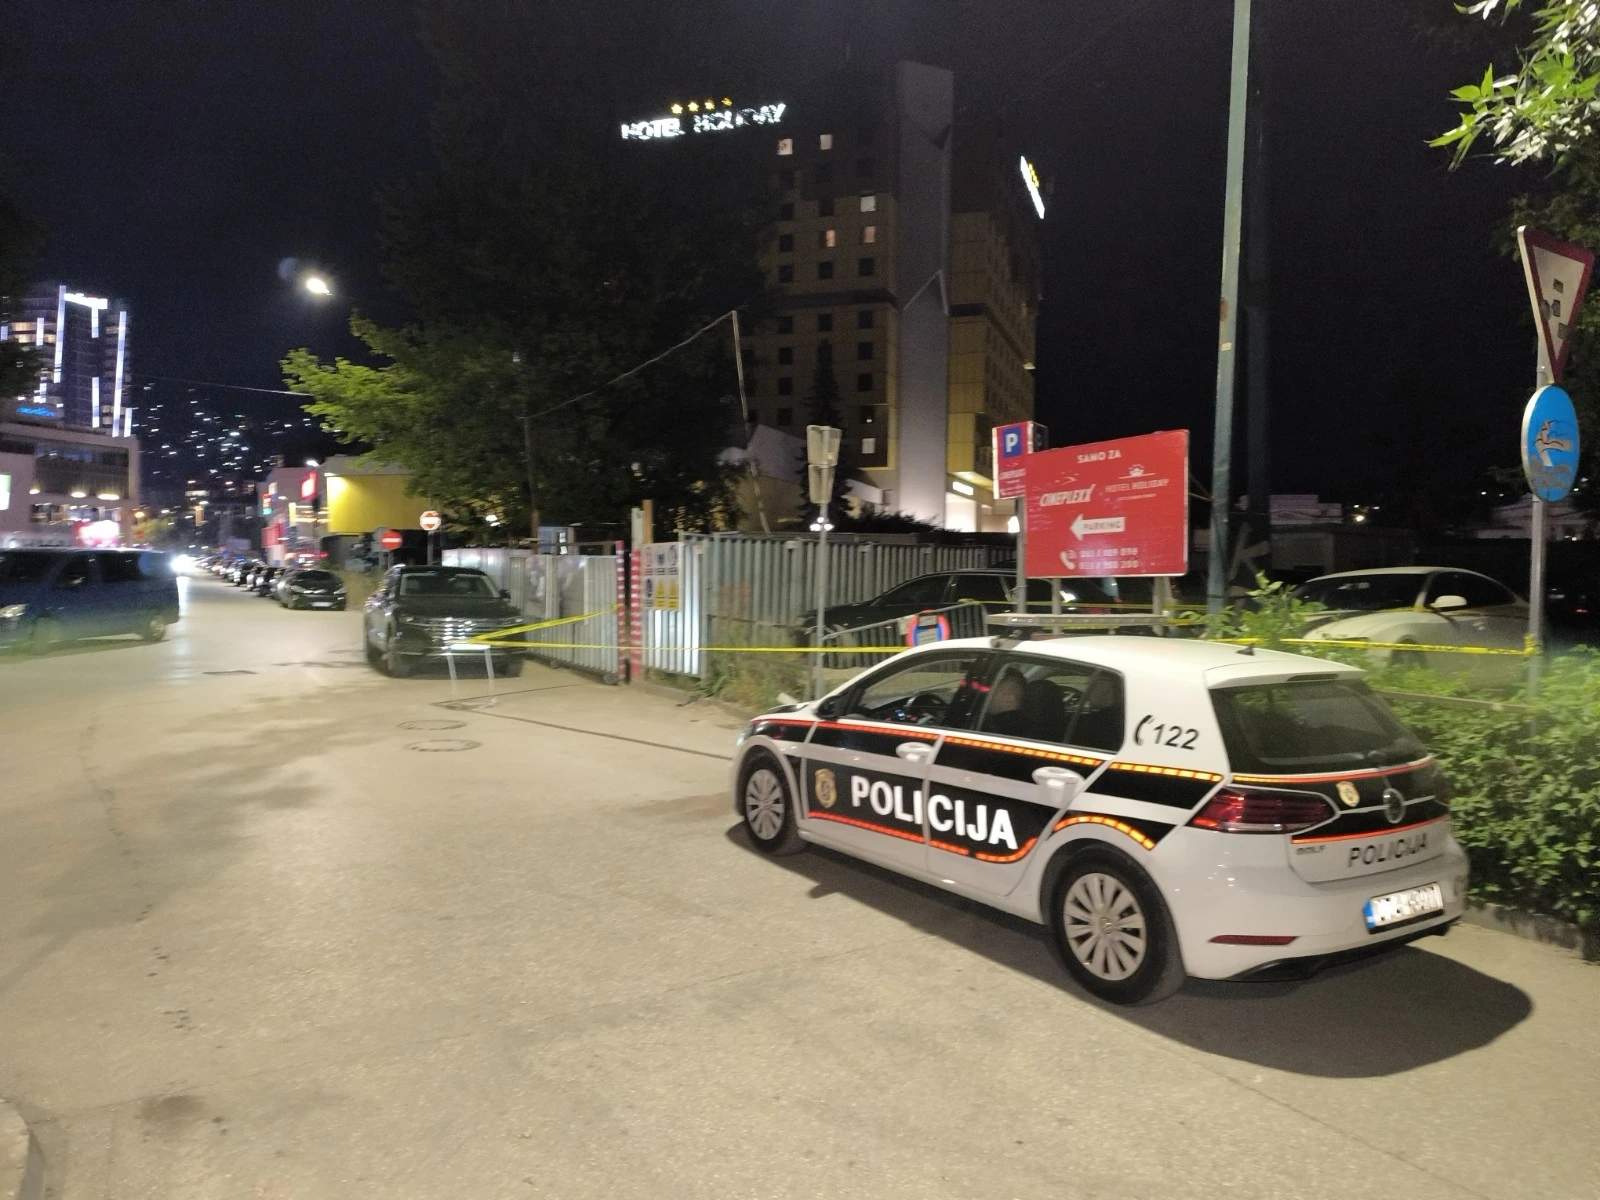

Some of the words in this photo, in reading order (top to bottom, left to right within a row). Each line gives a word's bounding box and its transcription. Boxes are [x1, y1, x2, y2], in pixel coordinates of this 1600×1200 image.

[621, 118, 685, 140] HOTEL
[1005, 433, 1019, 453] P
[1077, 451, 1106, 463] SAMO
[1108, 449, 1121, 460] ZA
[1153, 723, 1199, 750] 122
[851, 775, 1019, 850] POLICIJA
